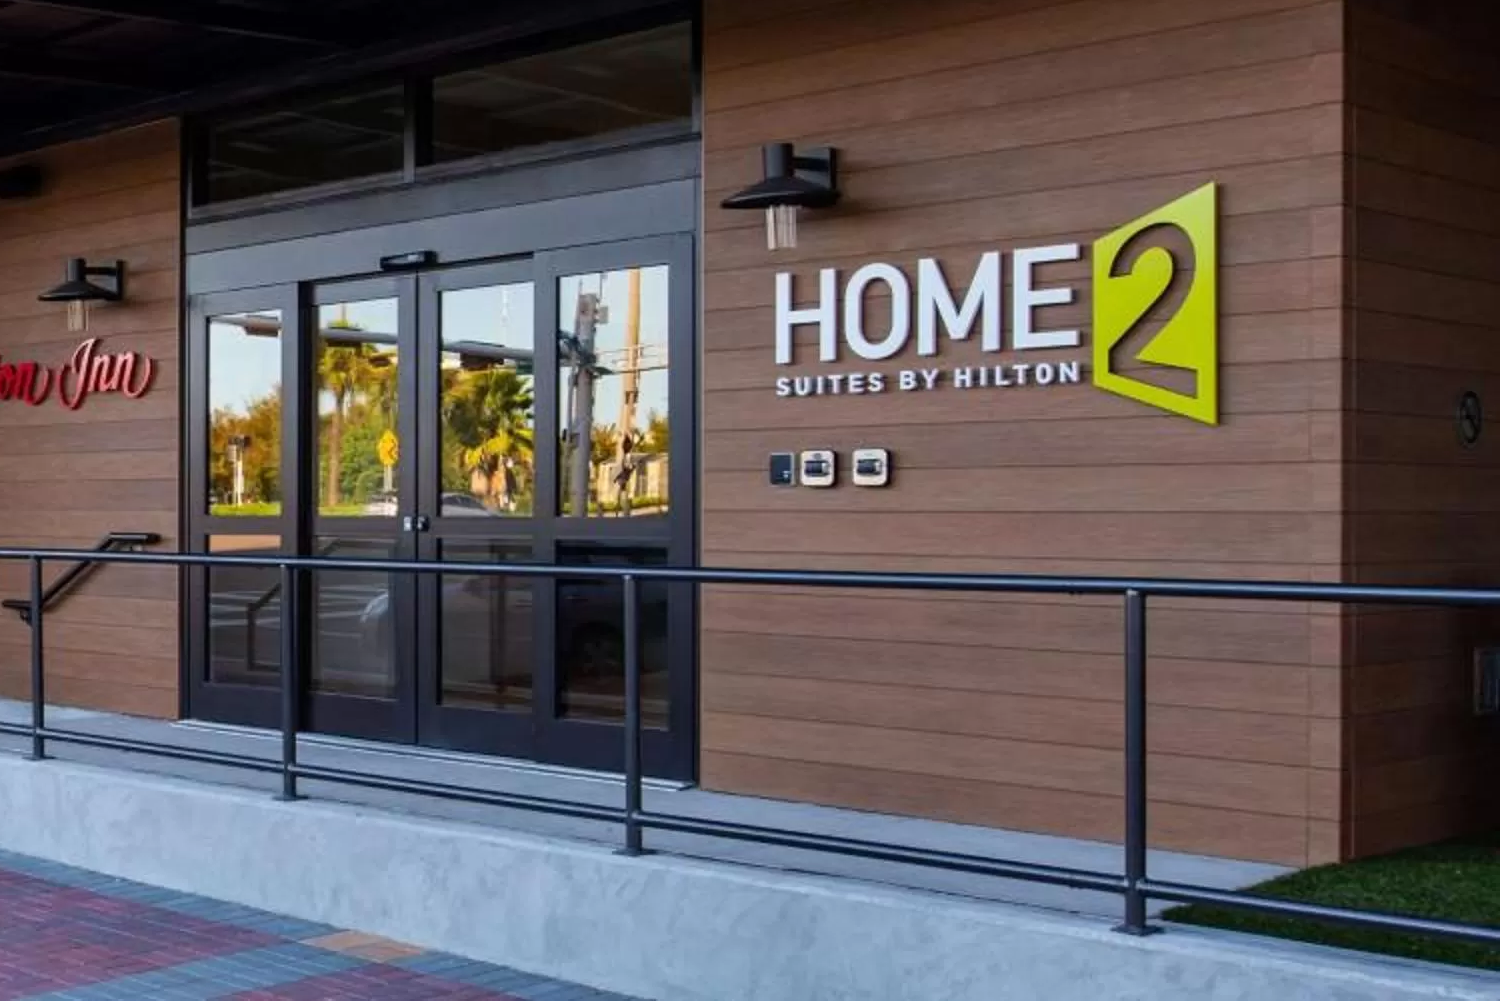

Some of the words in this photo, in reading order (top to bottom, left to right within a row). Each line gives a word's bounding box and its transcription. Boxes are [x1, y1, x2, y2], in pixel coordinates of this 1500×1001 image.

[775, 242, 1081, 365] HOME
[1108, 221, 1199, 399] 2
[57, 337, 154, 410] Inn
[775, 373, 885, 397] SUITES
[900, 369, 940, 391] BY
[954, 360, 1080, 388] HILTON
